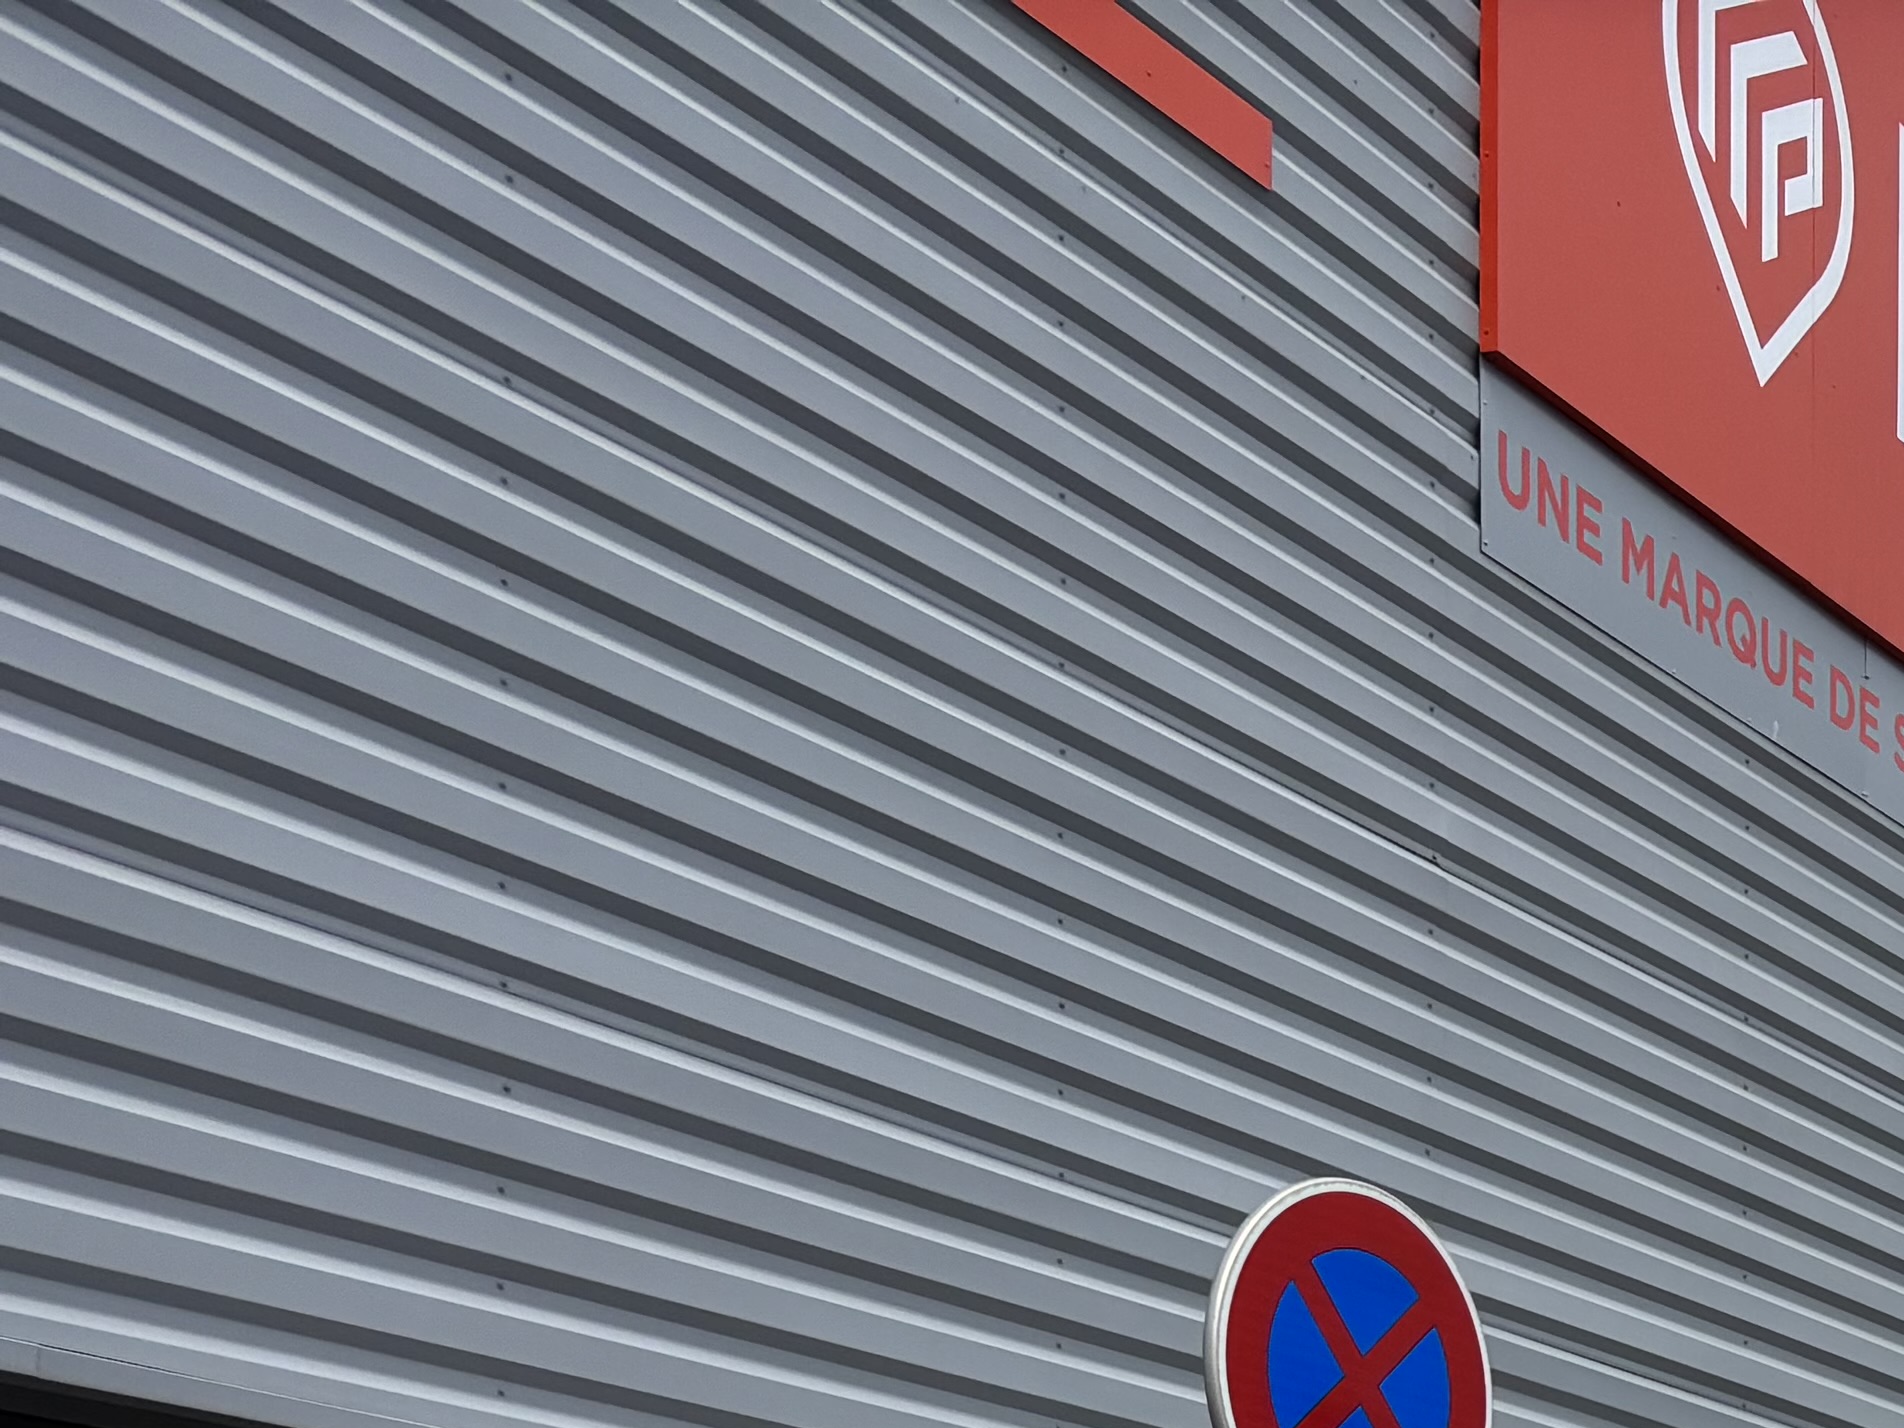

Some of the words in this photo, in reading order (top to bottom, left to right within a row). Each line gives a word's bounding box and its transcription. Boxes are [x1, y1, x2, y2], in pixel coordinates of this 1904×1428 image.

[1498, 429, 1603, 566] UNE
[1621, 516, 1815, 710] MARQUE
[1829, 663, 1880, 754] DE
